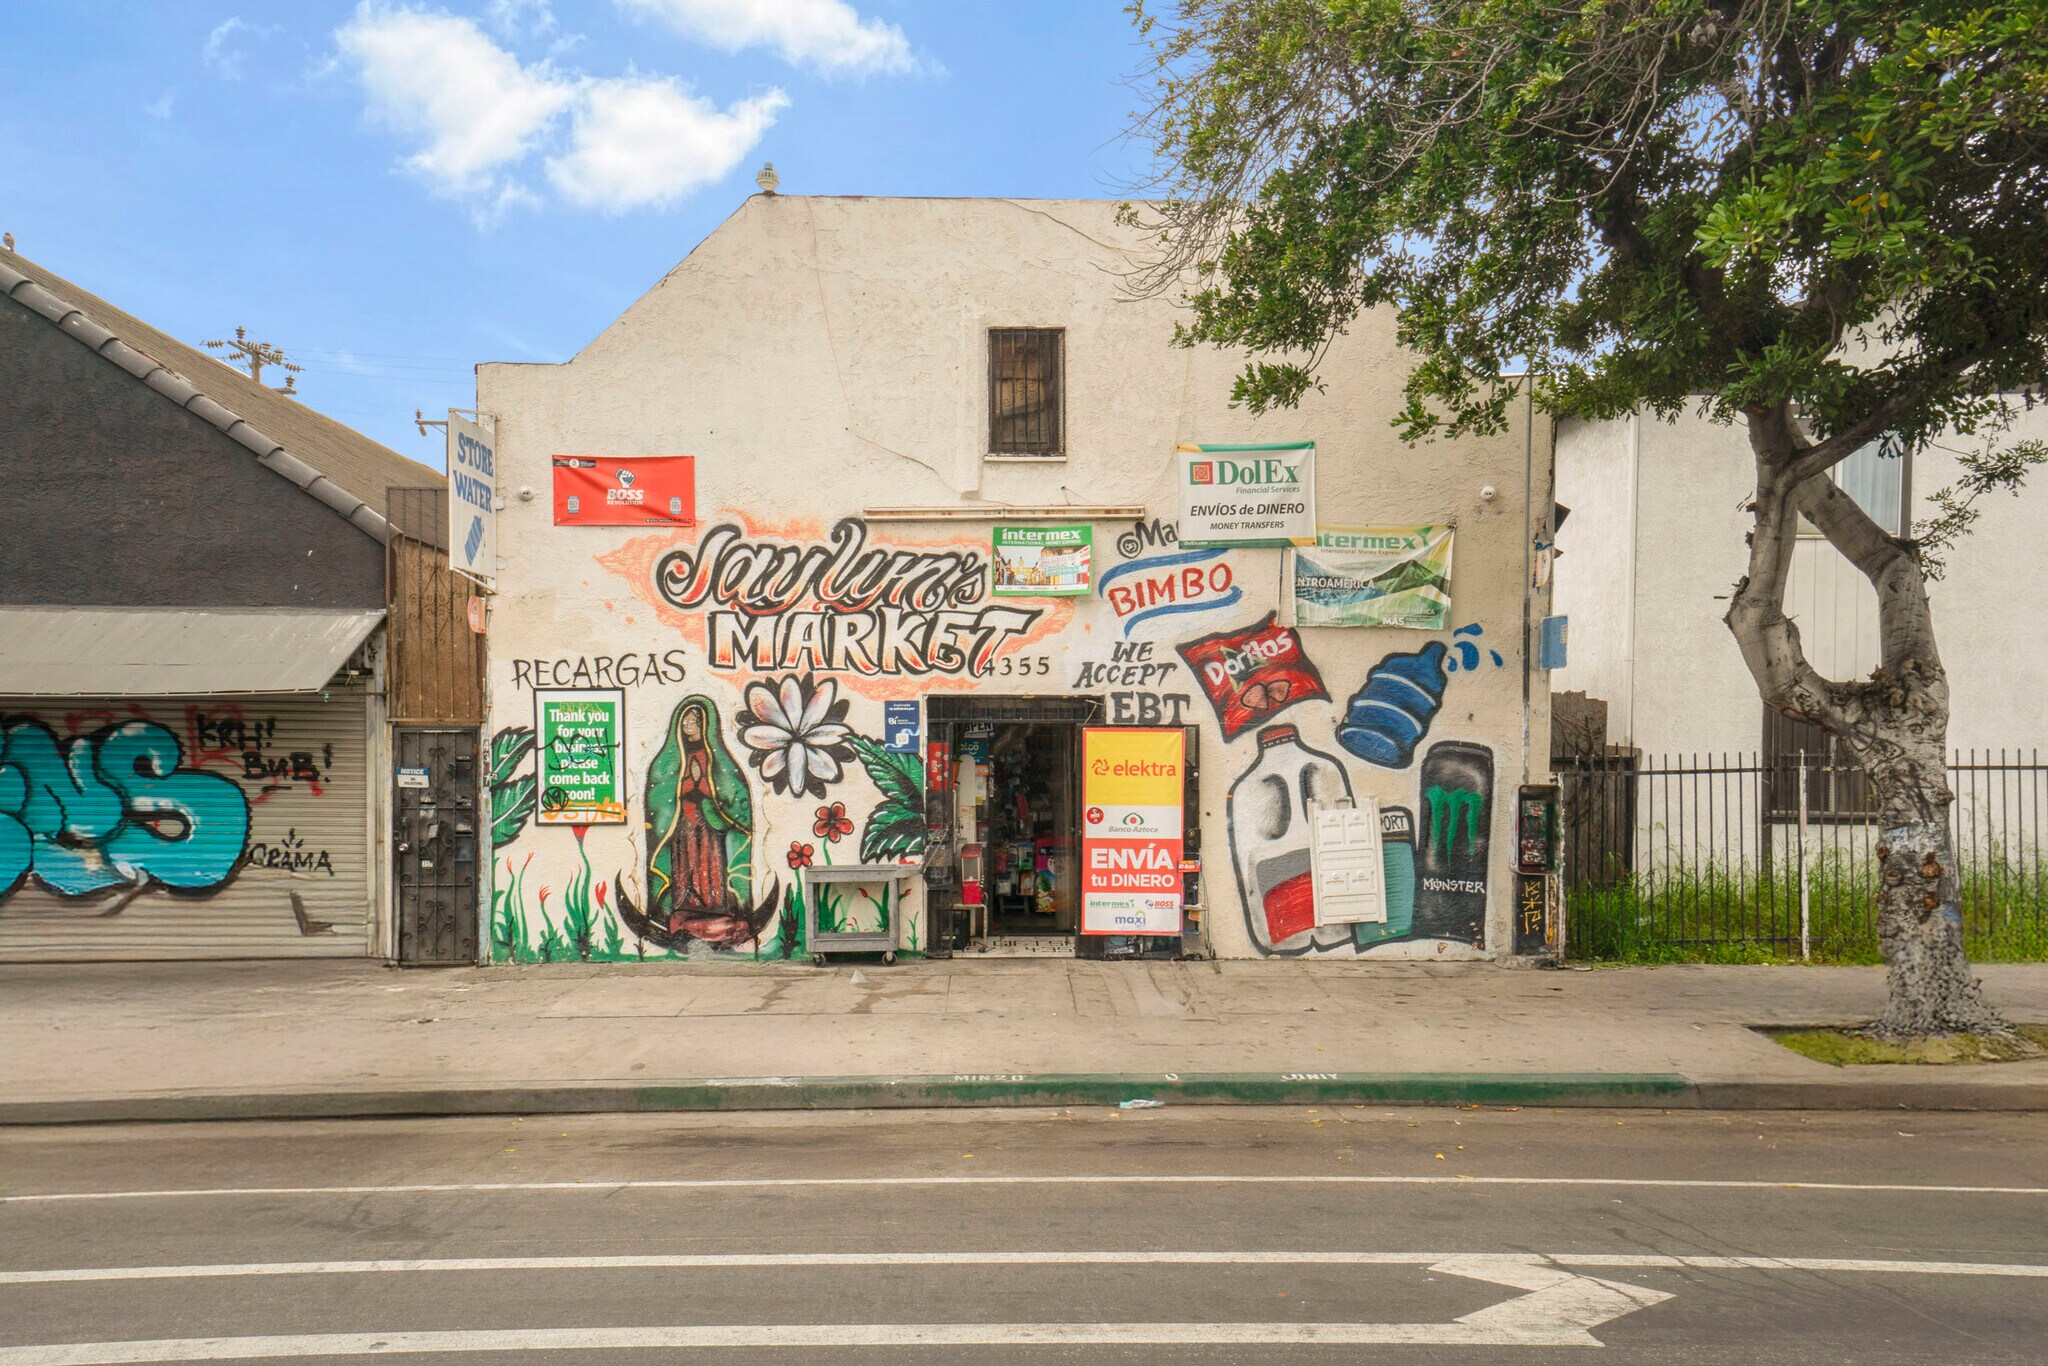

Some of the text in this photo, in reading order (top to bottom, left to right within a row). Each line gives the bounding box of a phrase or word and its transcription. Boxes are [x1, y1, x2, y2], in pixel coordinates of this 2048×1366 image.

[457, 431, 494, 477] STORE
[1216, 459, 1299, 485] DolEx
[453, 469, 492, 514] WATER
[607, 488, 644, 500] BOSS
[1235, 485, 1300, 495] Financial Services
[1190, 502, 1305, 517] ENVÍOS de DINERO
[1002, 527, 1082, 541] intermex
[1209, 520, 1285, 530] MONEY TRANSFERS
[1108, 562, 1233, 618] BIMBO
[709, 606, 1044, 679] MARKET
[1111, 641, 1153, 663] WE
[1204, 631, 1293, 686] Doritos
[512, 650, 687, 690] RECARGAS
[983, 656, 1051, 677] 4355
[1072, 662, 1178, 689] ACCEPT
[549, 709, 610, 725] Thank you
[1110, 691, 1191, 726] EBT
[557, 725, 606, 740] for your
[560, 755, 599, 772] please
[1112, 759, 1177, 777] elektra
[549, 771, 610, 785] come back
[1091, 843, 1175, 870] ENVÍA
[1091, 873, 1175, 888] tu DINERO
[1089, 899, 1130, 908] intermex
[1115, 915, 1146, 927] maxi
